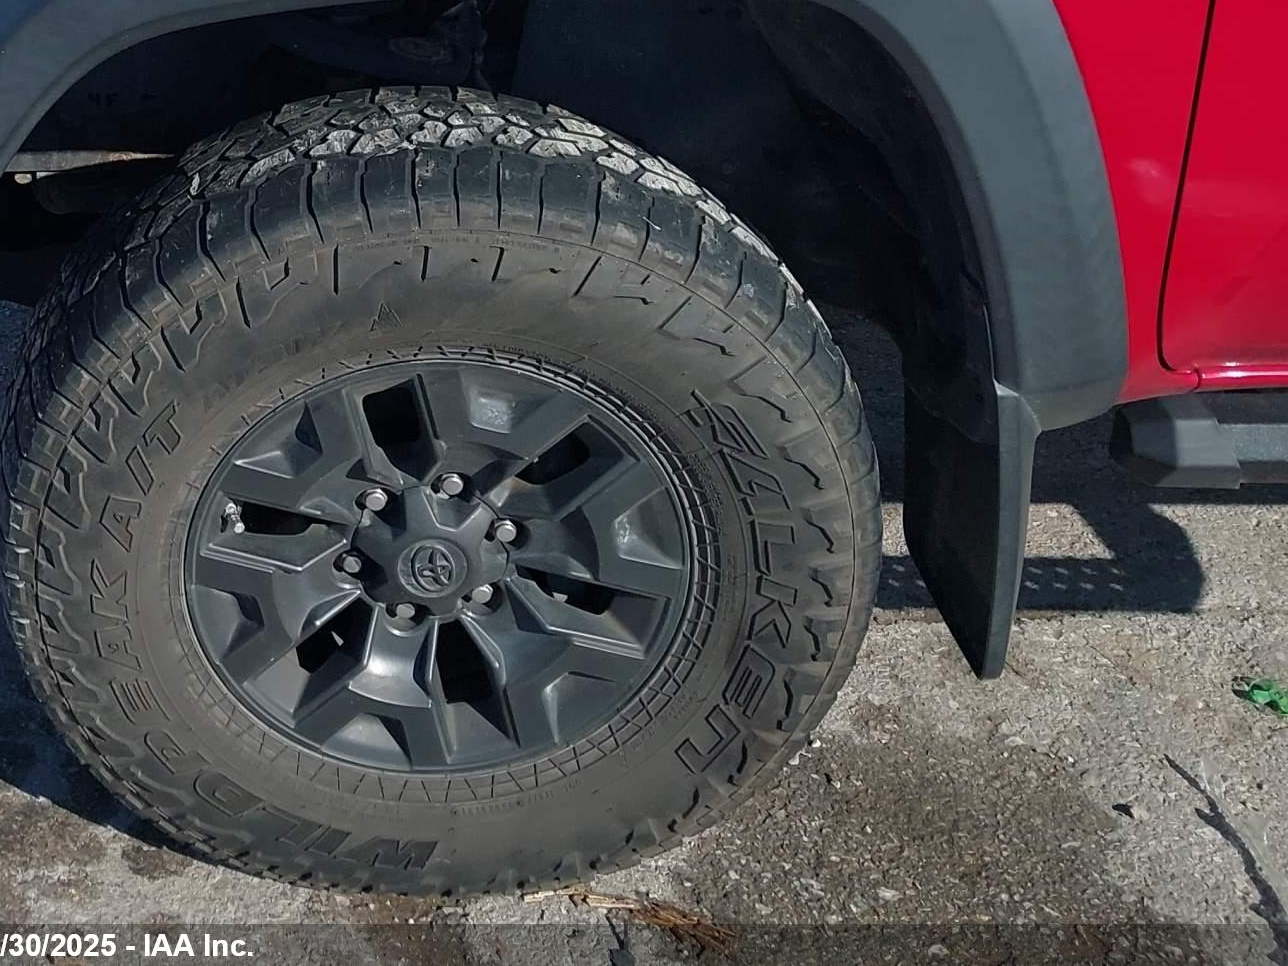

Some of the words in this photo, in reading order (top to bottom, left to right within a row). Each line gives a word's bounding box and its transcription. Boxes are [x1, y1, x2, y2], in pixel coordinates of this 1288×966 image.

[99, 400, 182, 553] A/T
[675, 388, 800, 776] FALKEN
[90, 557, 440, 871] WILDPEAK
